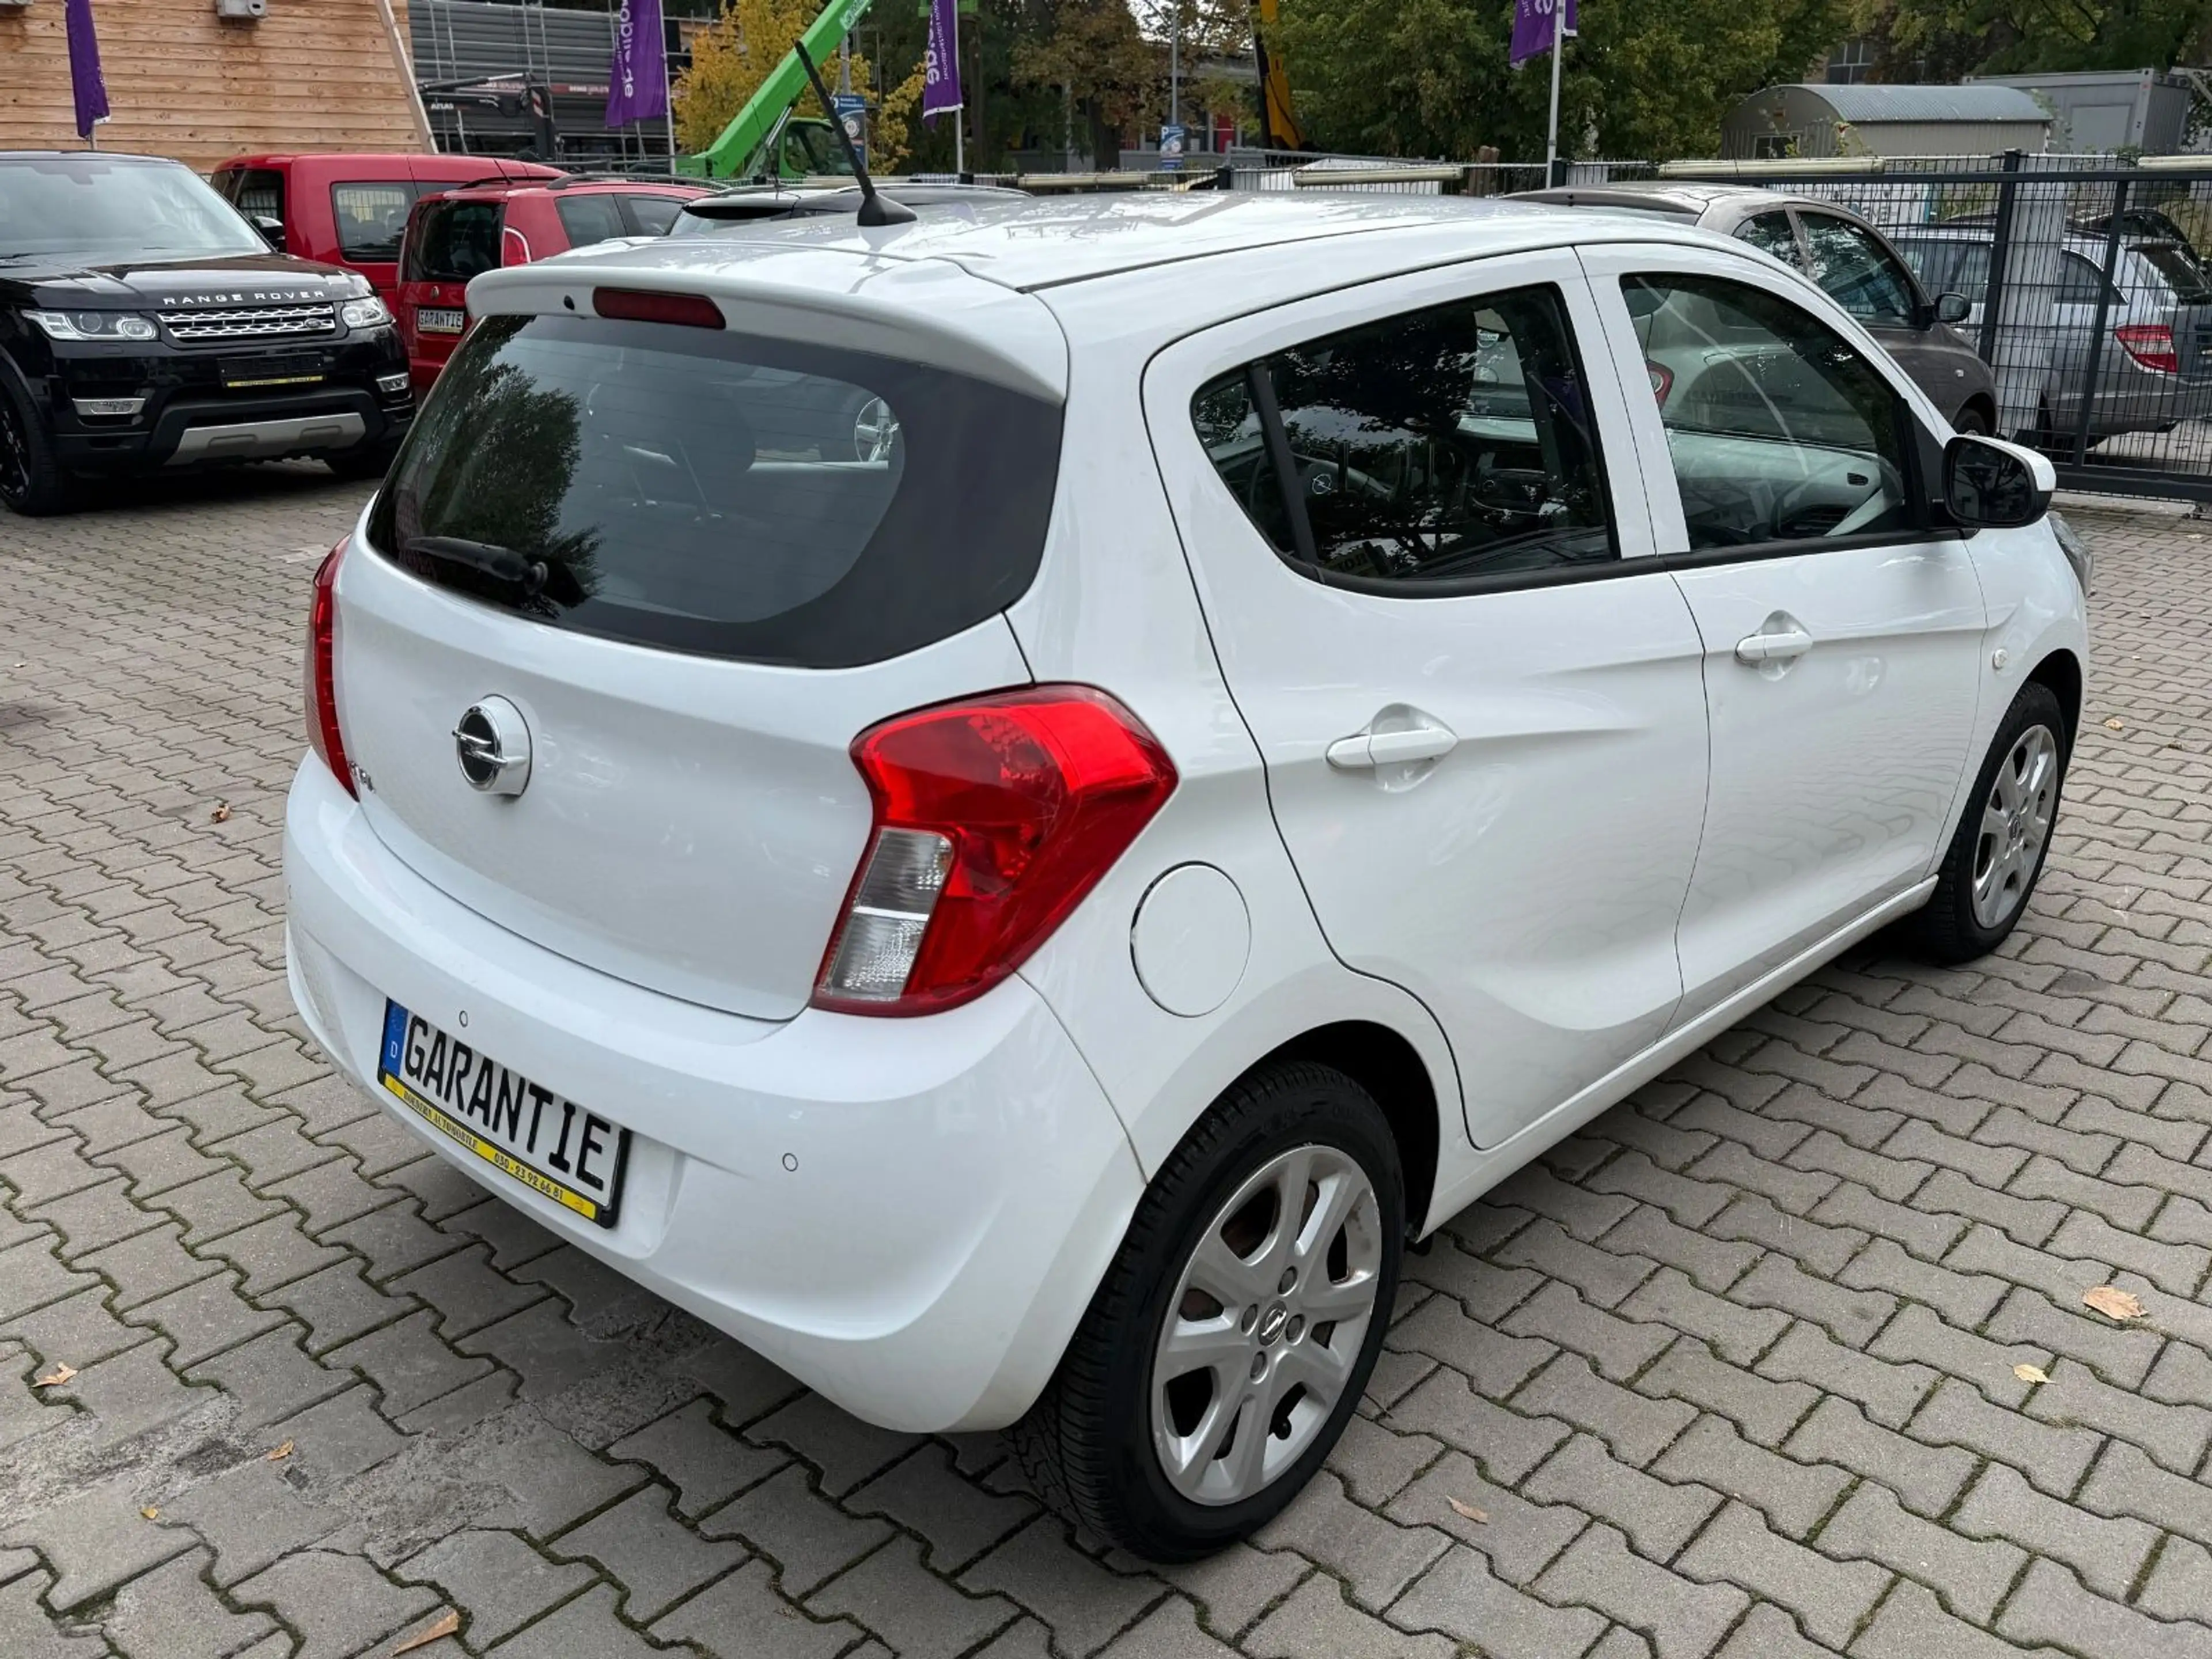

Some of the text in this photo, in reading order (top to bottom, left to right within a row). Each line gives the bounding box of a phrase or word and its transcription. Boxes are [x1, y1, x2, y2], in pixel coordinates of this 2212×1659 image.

[163, 290, 325, 305] RANGE ROVER
[419, 311, 463, 328] GARANTIE
[391, 1040, 398, 1059] D
[404, 1014, 612, 1191] GARANTIE
[515, 1165, 526, 1179] 23
[528, 1173, 539, 1187] 92
[540, 1180, 552, 1194] 66
[553, 1187, 564, 1200] 81
